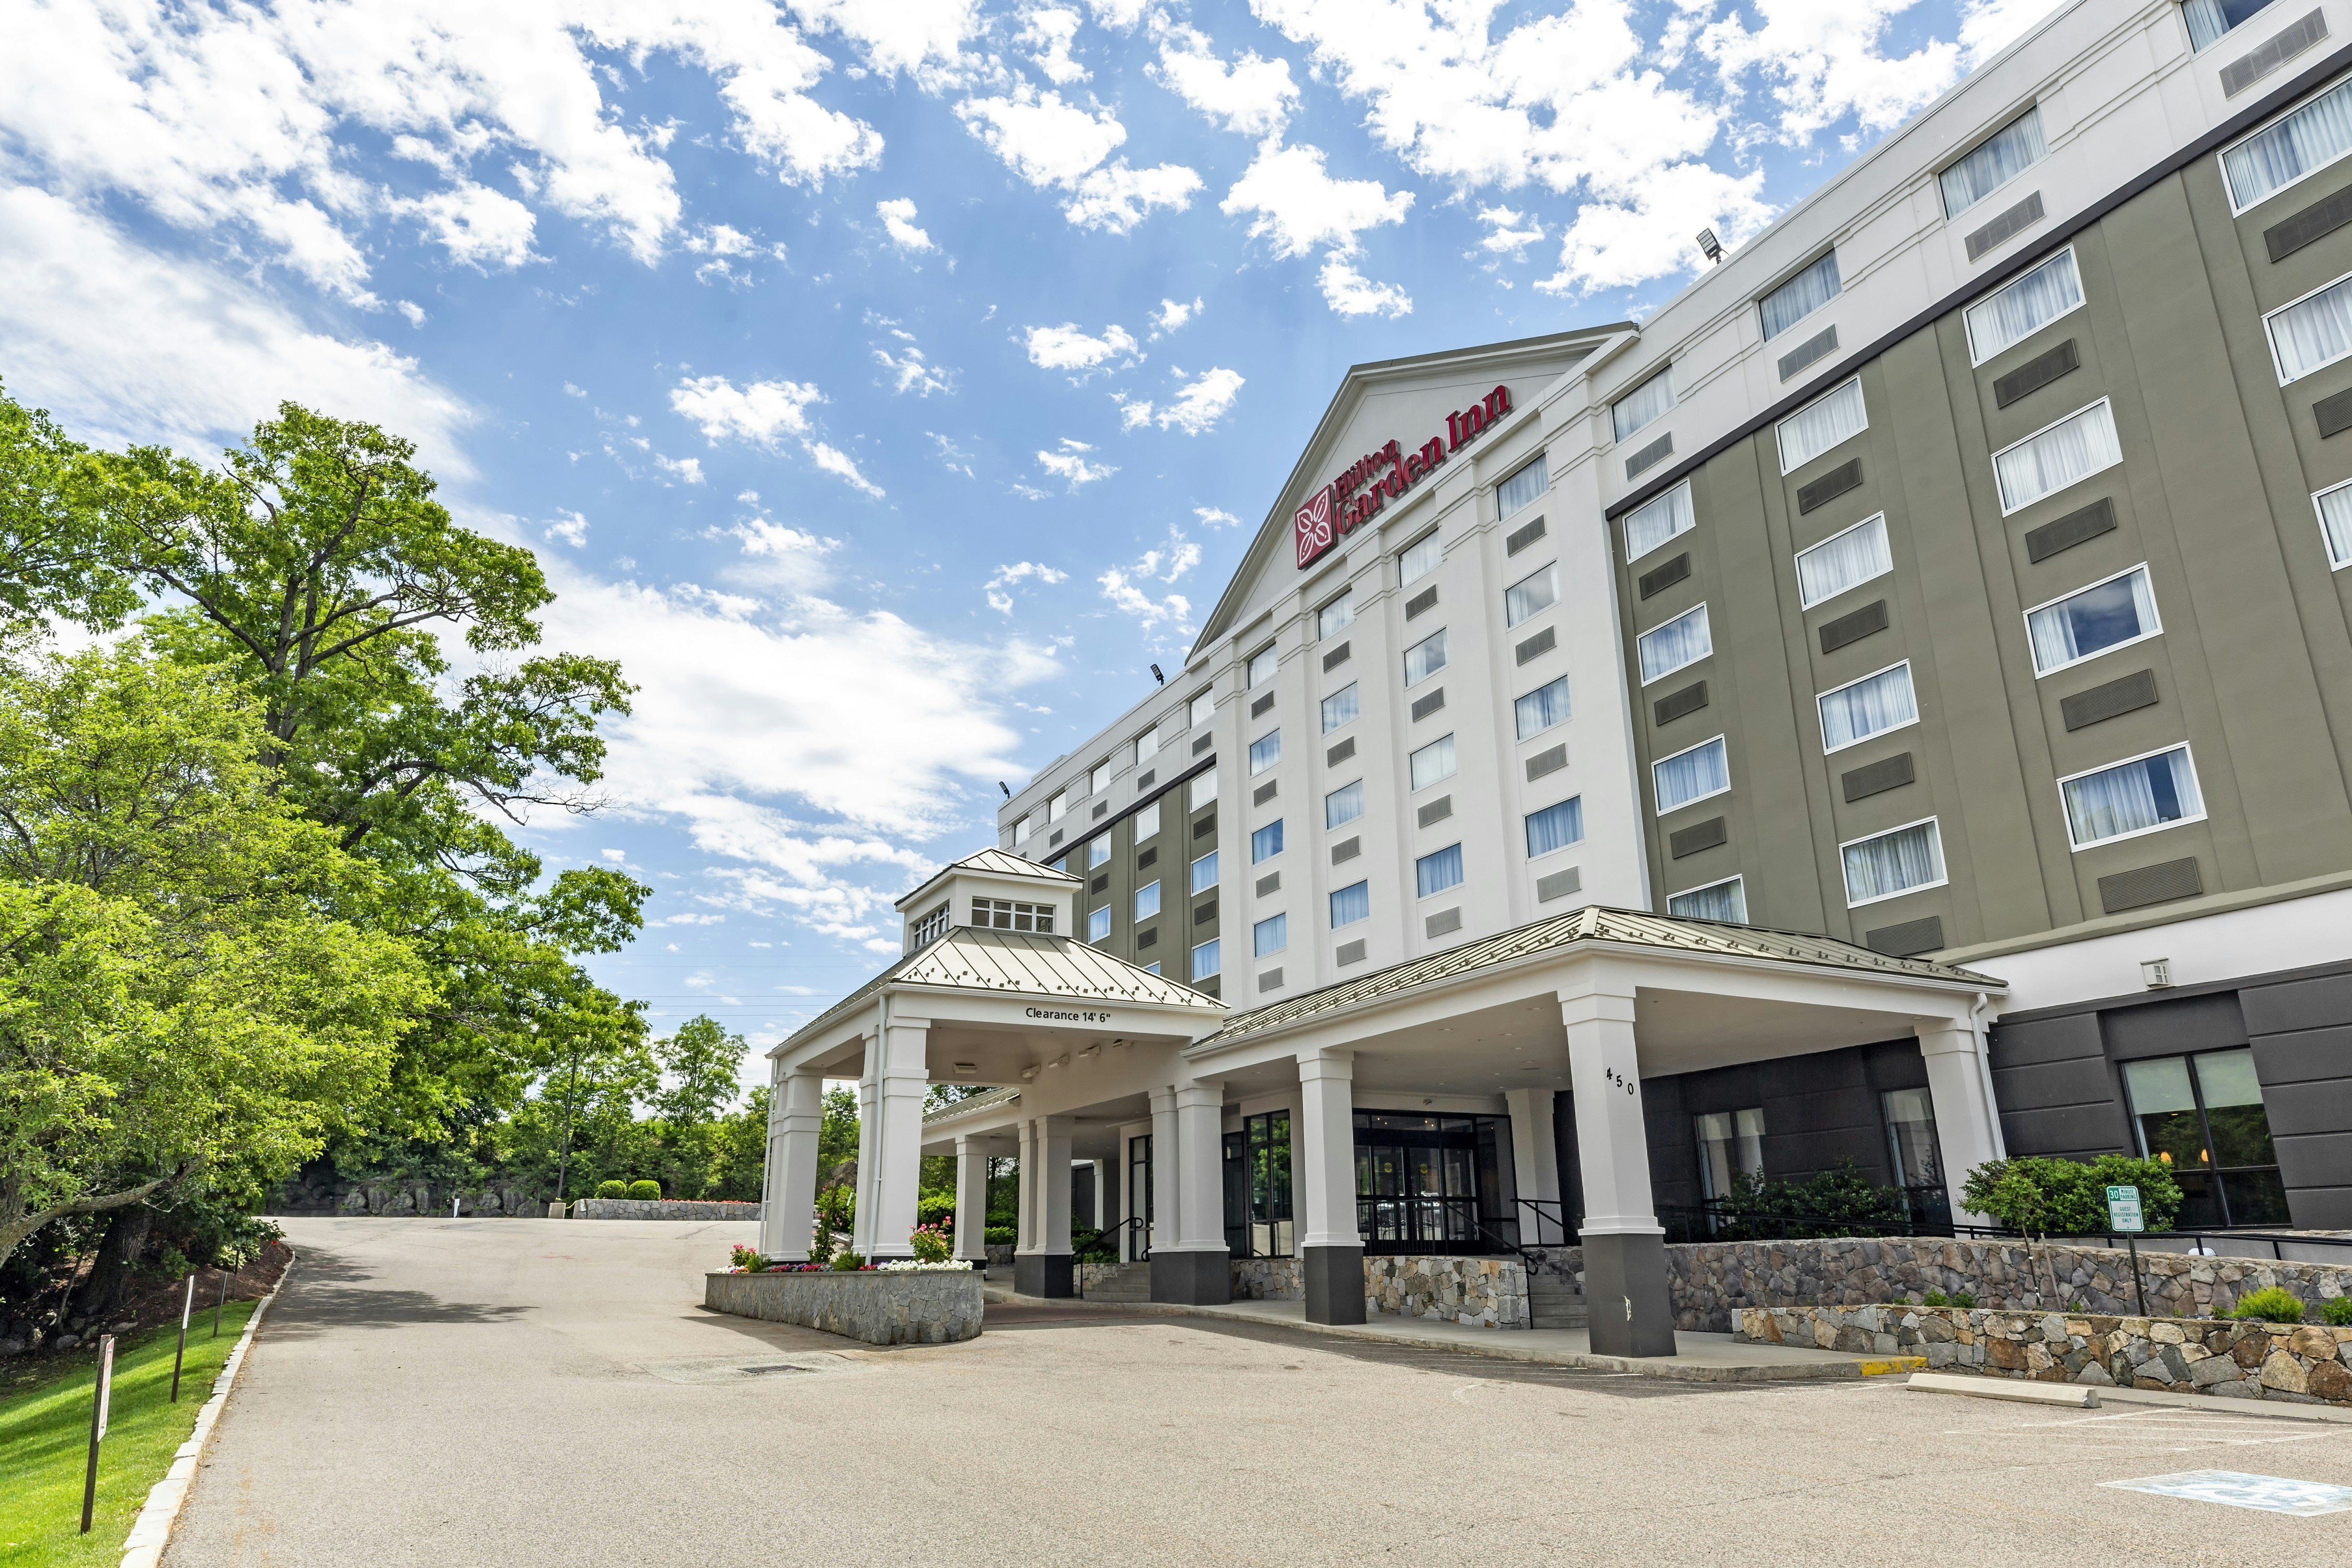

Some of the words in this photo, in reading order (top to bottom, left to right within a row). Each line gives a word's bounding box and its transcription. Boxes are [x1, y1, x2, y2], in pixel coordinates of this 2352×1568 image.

[1334, 439, 1401, 502] Hilton
[1335, 436, 1447, 534] Garden
[1445, 385, 1513, 453] Inn
[1025, 1007, 1079, 1021] Clearance
[1082, 1012, 1096, 1022] 14'
[1099, 1013, 1111, 1022] 6"
[1606, 1067, 1634, 1095] 450
[2109, 1190, 2119, 1199] 30
